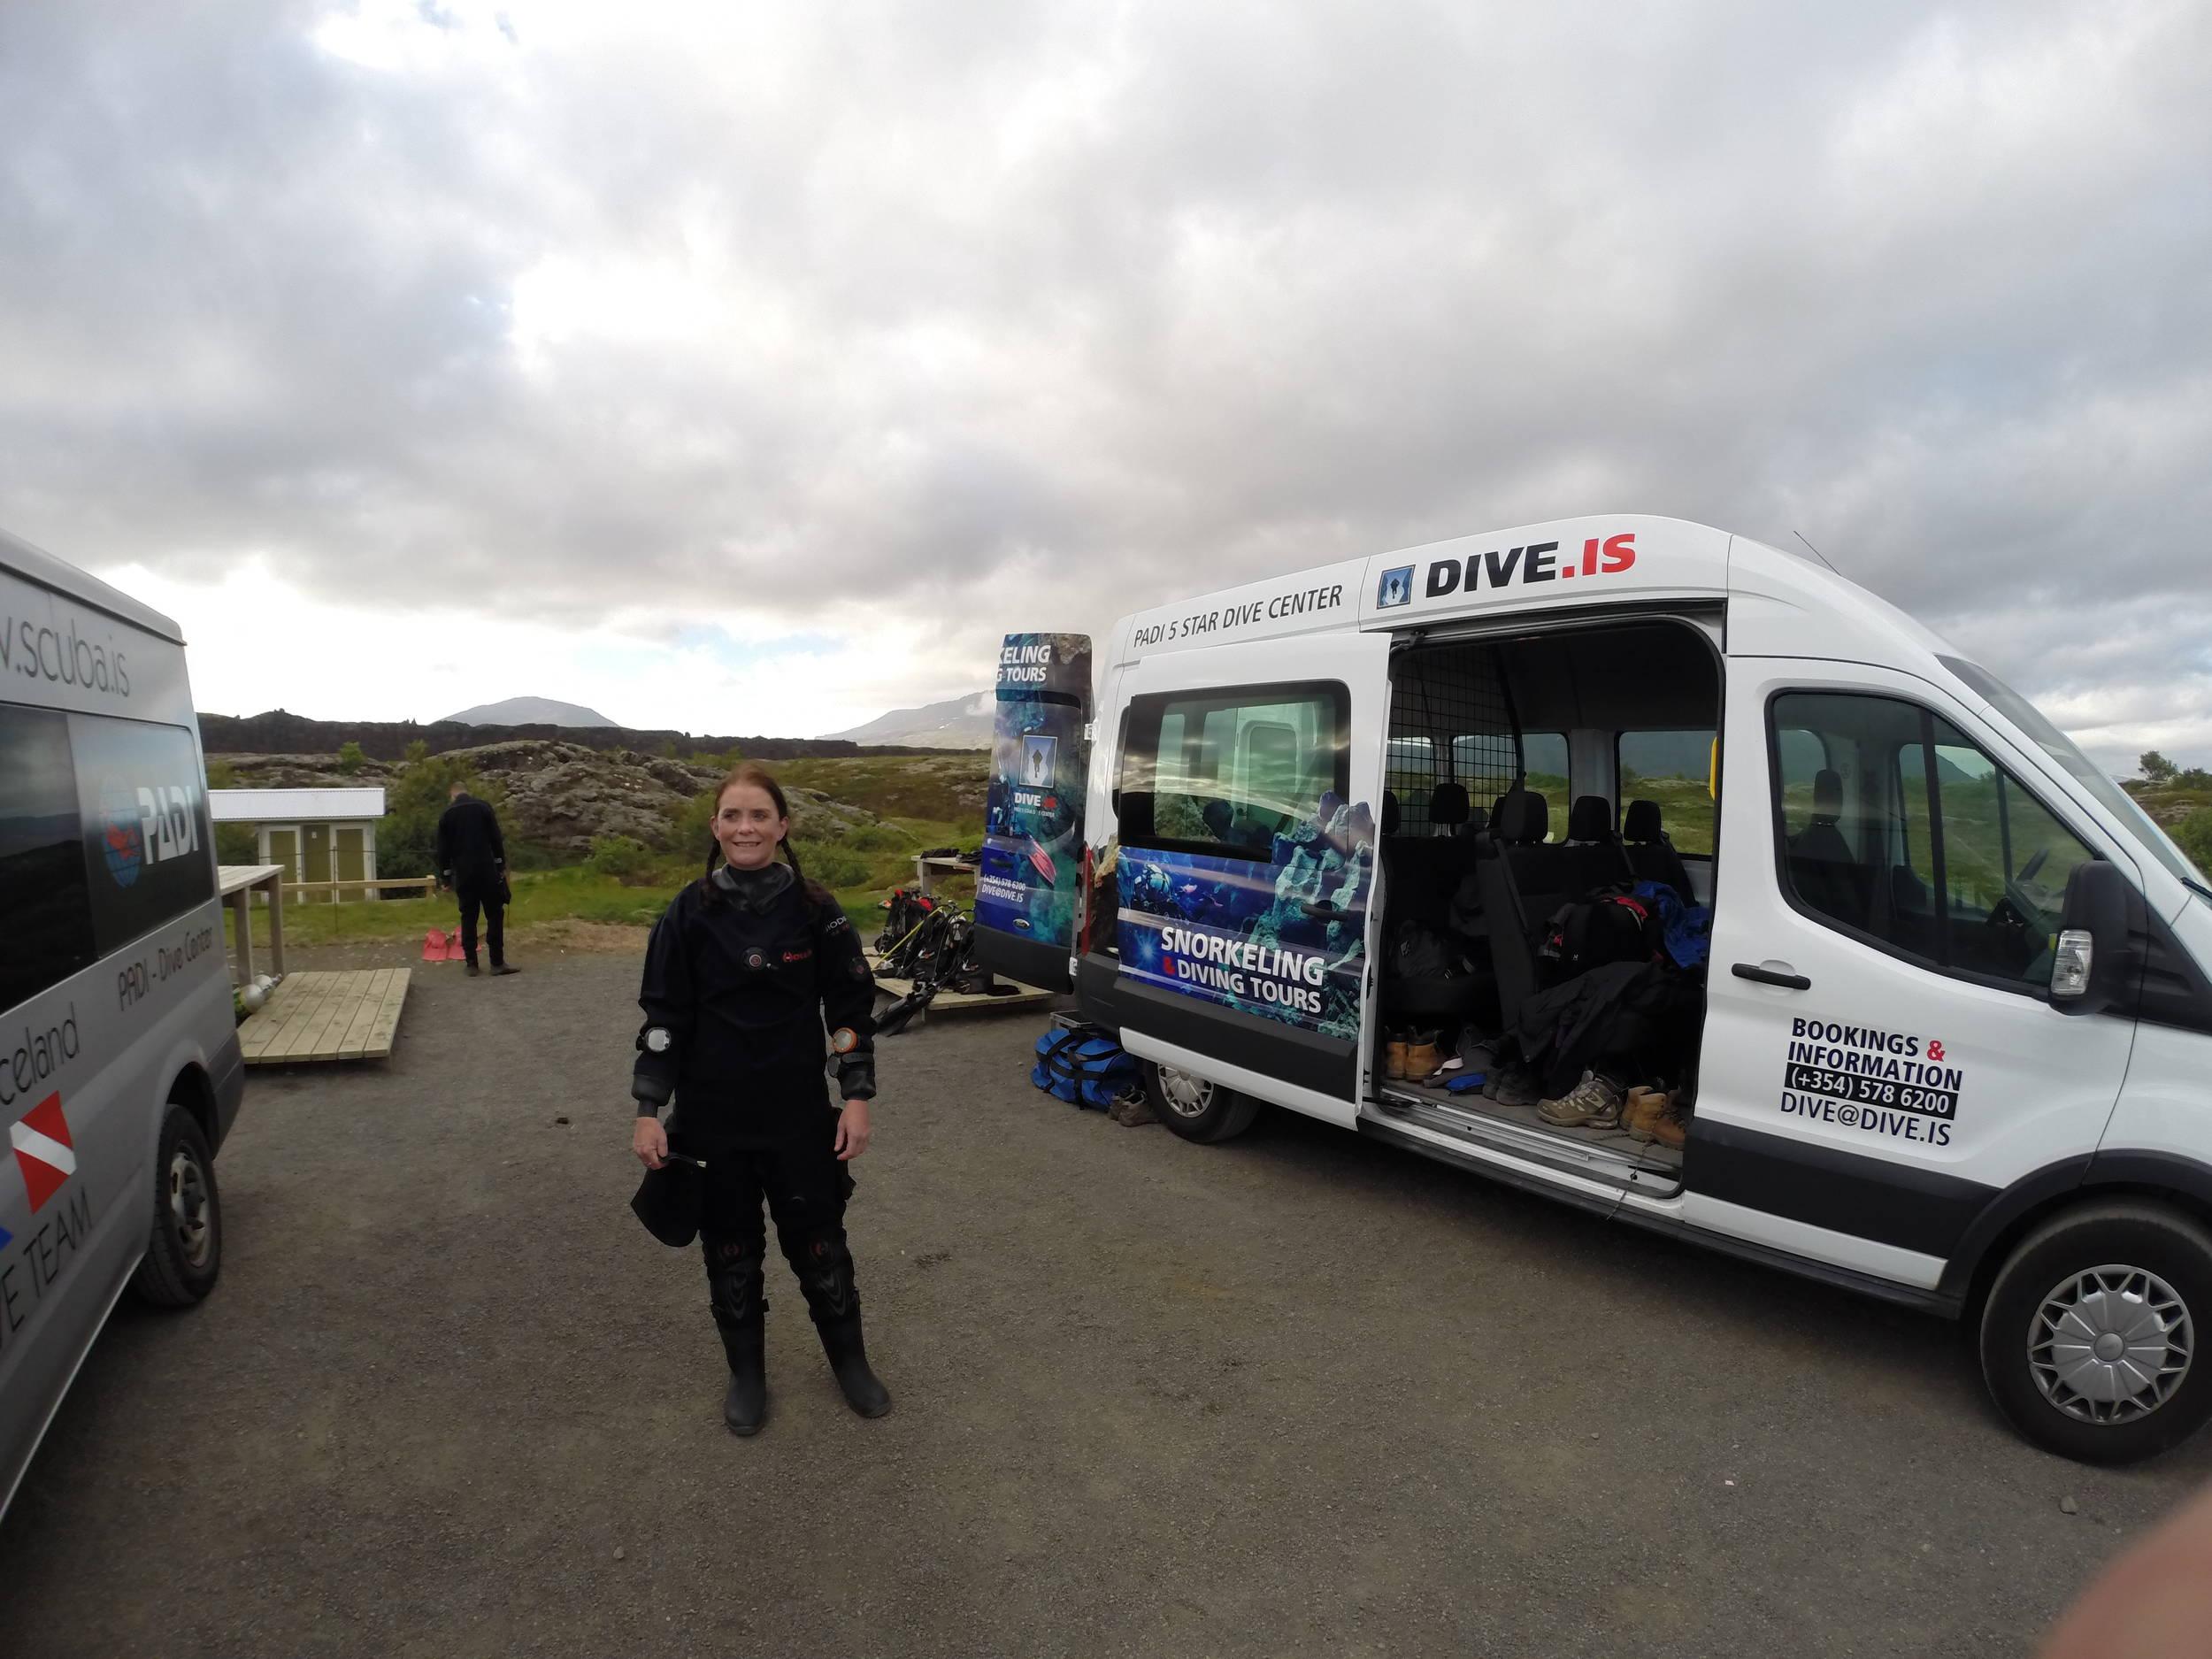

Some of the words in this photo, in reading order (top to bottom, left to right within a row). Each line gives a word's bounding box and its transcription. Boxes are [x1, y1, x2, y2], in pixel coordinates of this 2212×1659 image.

[1425, 533, 1636, 599] DIVE.IS
[1133, 623, 1165, 648] PADI
[1168, 620, 1179, 641] 5
[1181, 611, 1218, 638] STAR
[1223, 601, 1263, 629] DIVE
[1268, 584, 1343, 619] CENTER
[1006, 666, 1047, 682] TOURS
[136, 786, 200, 865] PADI
[981, 883, 1025, 903] DIVE@DIVE.IS
[118, 957, 150, 1011] PADI
[157, 948, 183, 982] Dive
[1160, 926, 1325, 987] SNORKELING
[1177, 958, 1245, 995] DIVING
[1249, 977, 1322, 1015] TOURS
[1787, 1041, 1963, 1092] INFORMATION
[1791, 1017, 1919, 1057] BOOKINGS
[1926, 1039, 1946, 1063] &
[1791, 1066, 1854, 1099] (+354)
[1858, 1081, 1895, 1103] 578
[1900, 1087, 1949, 1114] 6200
[1780, 1091, 1952, 1147] DIVE@DIVE.IS
[23, 1185, 93, 1299] TEAM
